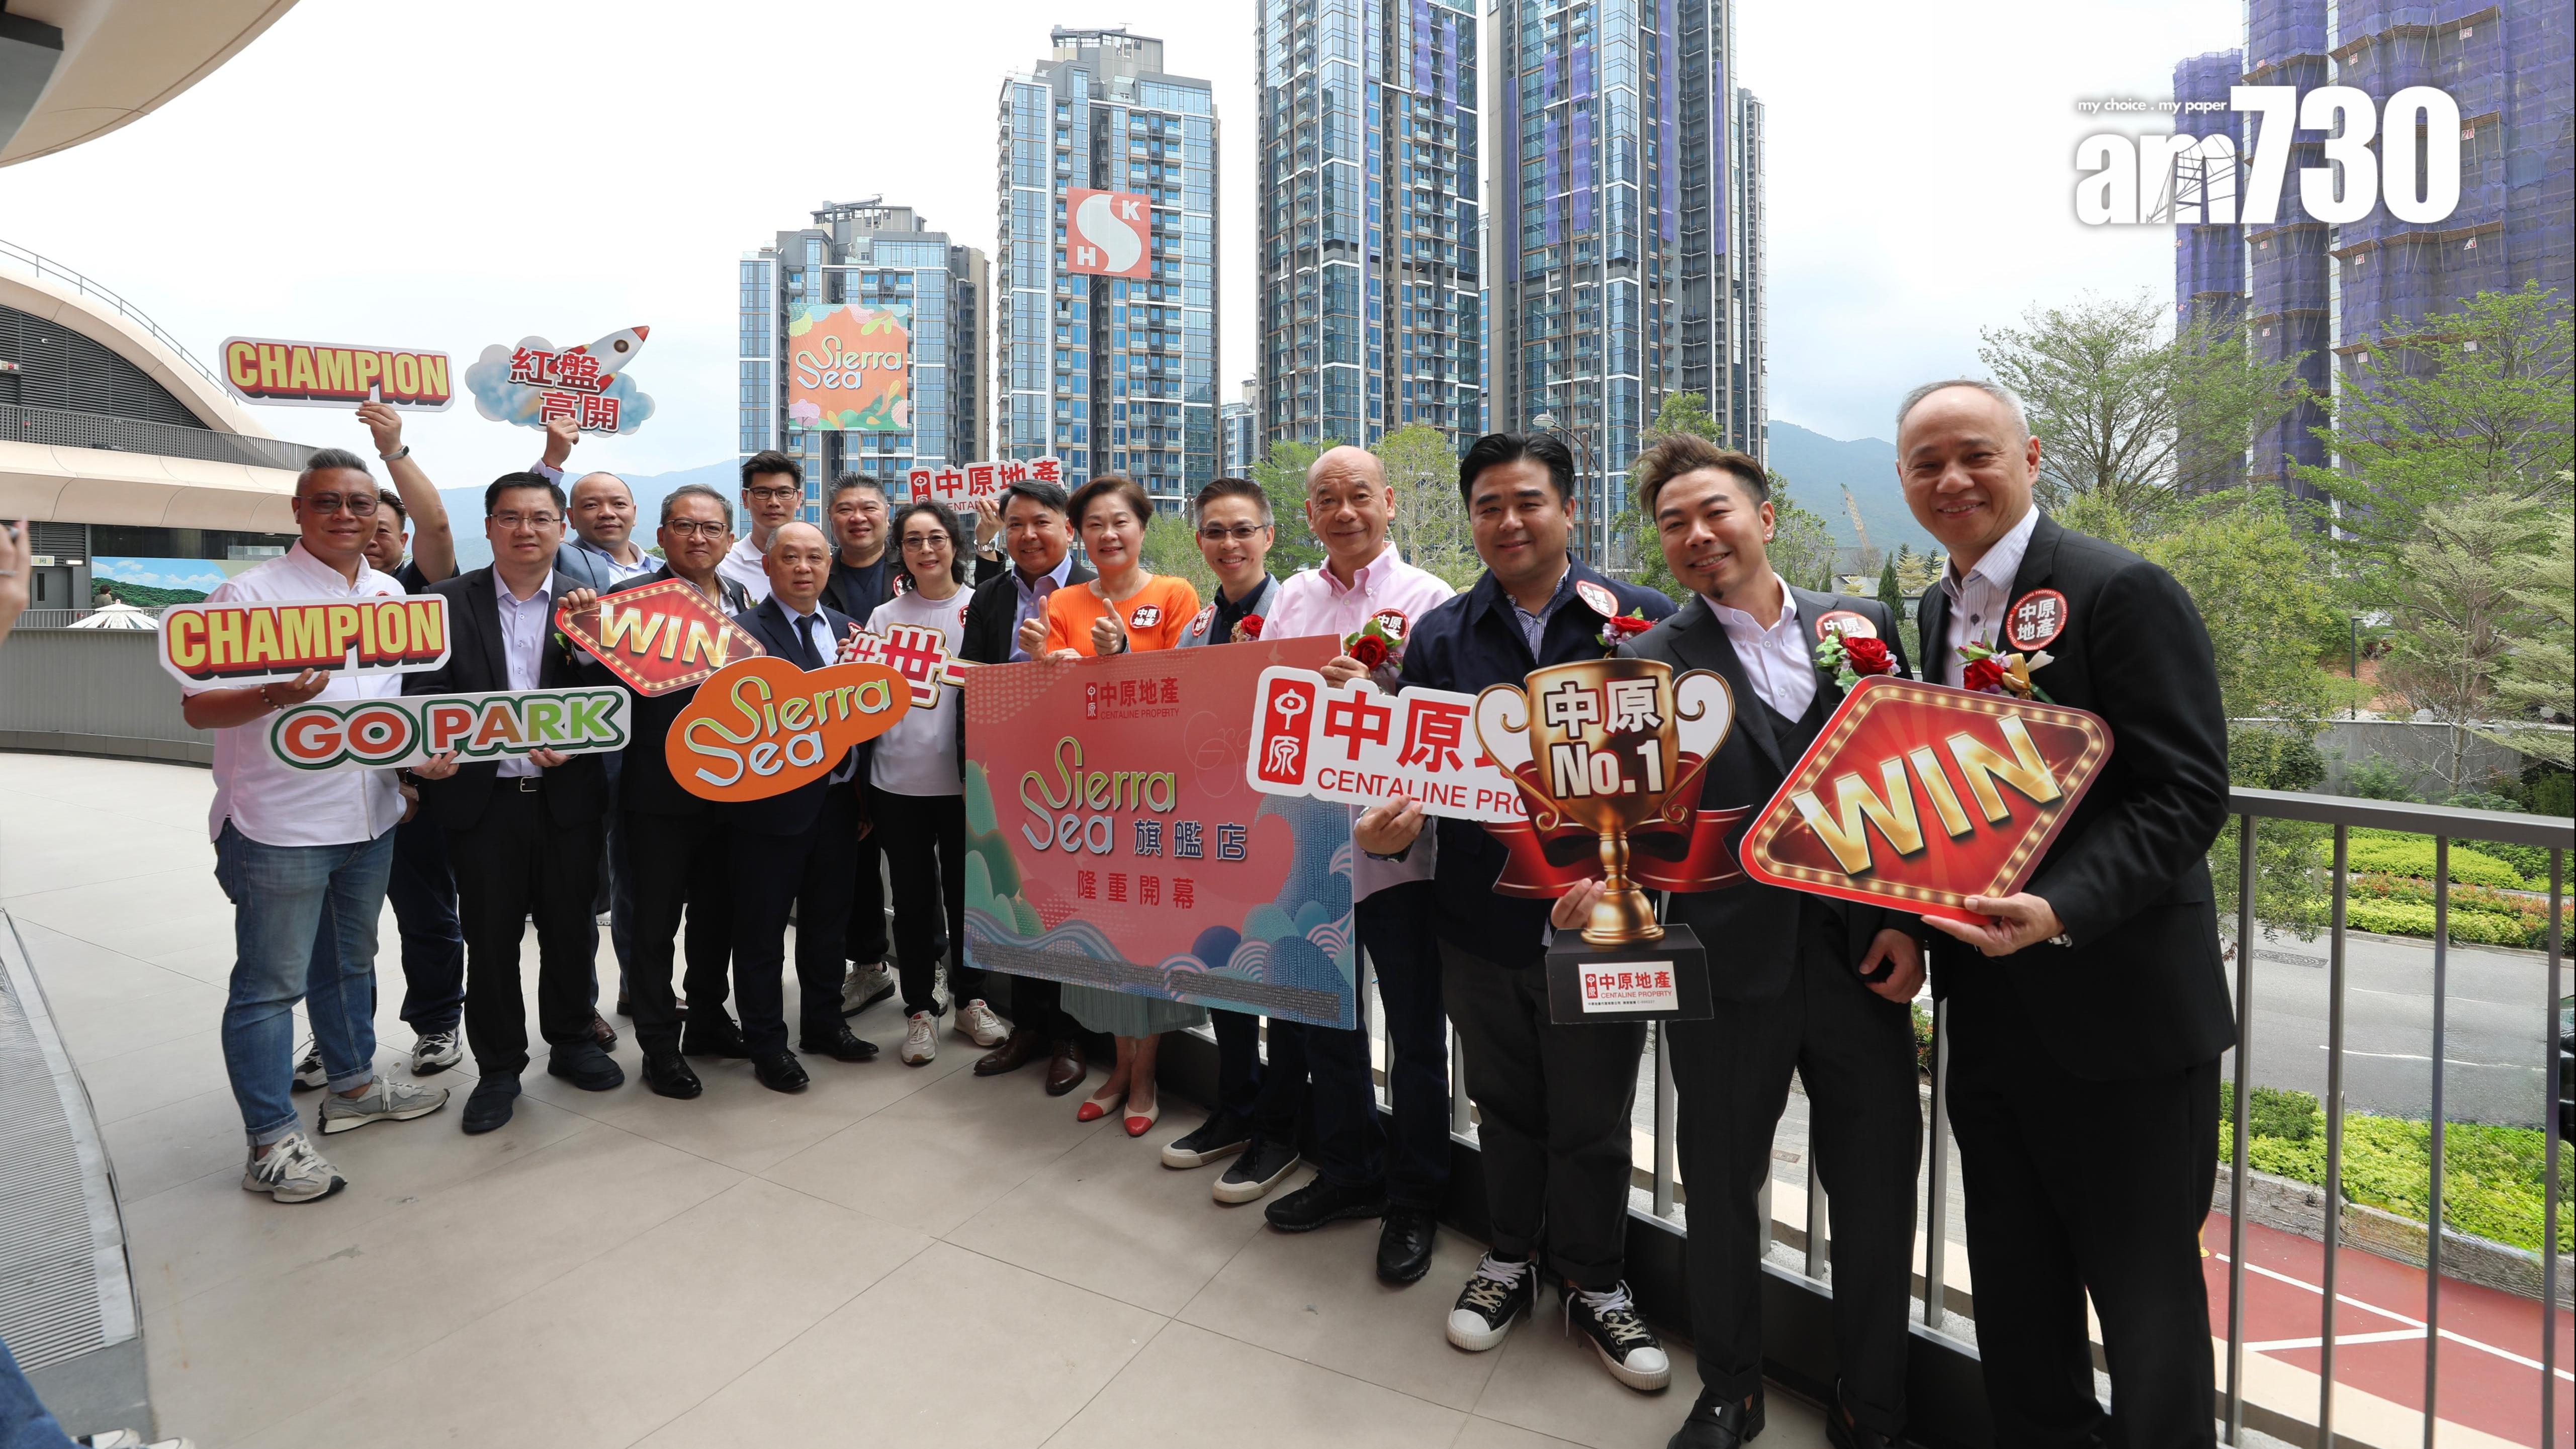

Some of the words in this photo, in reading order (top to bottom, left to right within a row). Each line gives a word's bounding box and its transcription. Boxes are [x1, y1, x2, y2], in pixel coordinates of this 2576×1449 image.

[2462, 129, 2473, 139] 20
[2357, 254, 2363, 263] 15
[228, 340, 450, 397] CHAMPION
[509, 346, 601, 392] 紅盤
[795, 335, 902, 371] Sierra
[2359, 353, 2367, 361] 10
[796, 366, 862, 390] Sea
[539, 392, 620, 433] 高開
[1136, 608, 1158, 618] 中原
[1378, 614, 1403, 629] 中原
[2017, 617, 2055, 641] 地產
[2018, 597, 2057, 622] 中原
[169, 601, 446, 667] CHAMPION
[600, 603, 732, 667] WIN
[684, 676, 892, 745] Sierra
[1100, 677, 1180, 708] 中原地產
[1546, 678, 1661, 738] 中原
[284, 711, 406, 759] GO
[433, 700, 610, 749] PARK
[1100, 709, 1139, 720] CENTALINE
[1141, 708, 1180, 718] PROPERTY
[1323, 689, 1496, 773] 中原
[686, 729, 824, 787] Sea
[1020, 736, 1176, 813] Sierra
[1551, 739, 1663, 797] No.1
[1317, 767, 1468, 808] CENTALINE
[1791, 714, 2063, 875] WIN
[1021, 807, 1113, 855] Sea
[1133, 819, 1247, 860] 旗艦店
[1077, 870, 1195, 910] 隆重開幕
[1598, 971, 1671, 990] 中原地產
[1638, 990, 1672, 998] PROPERTY
